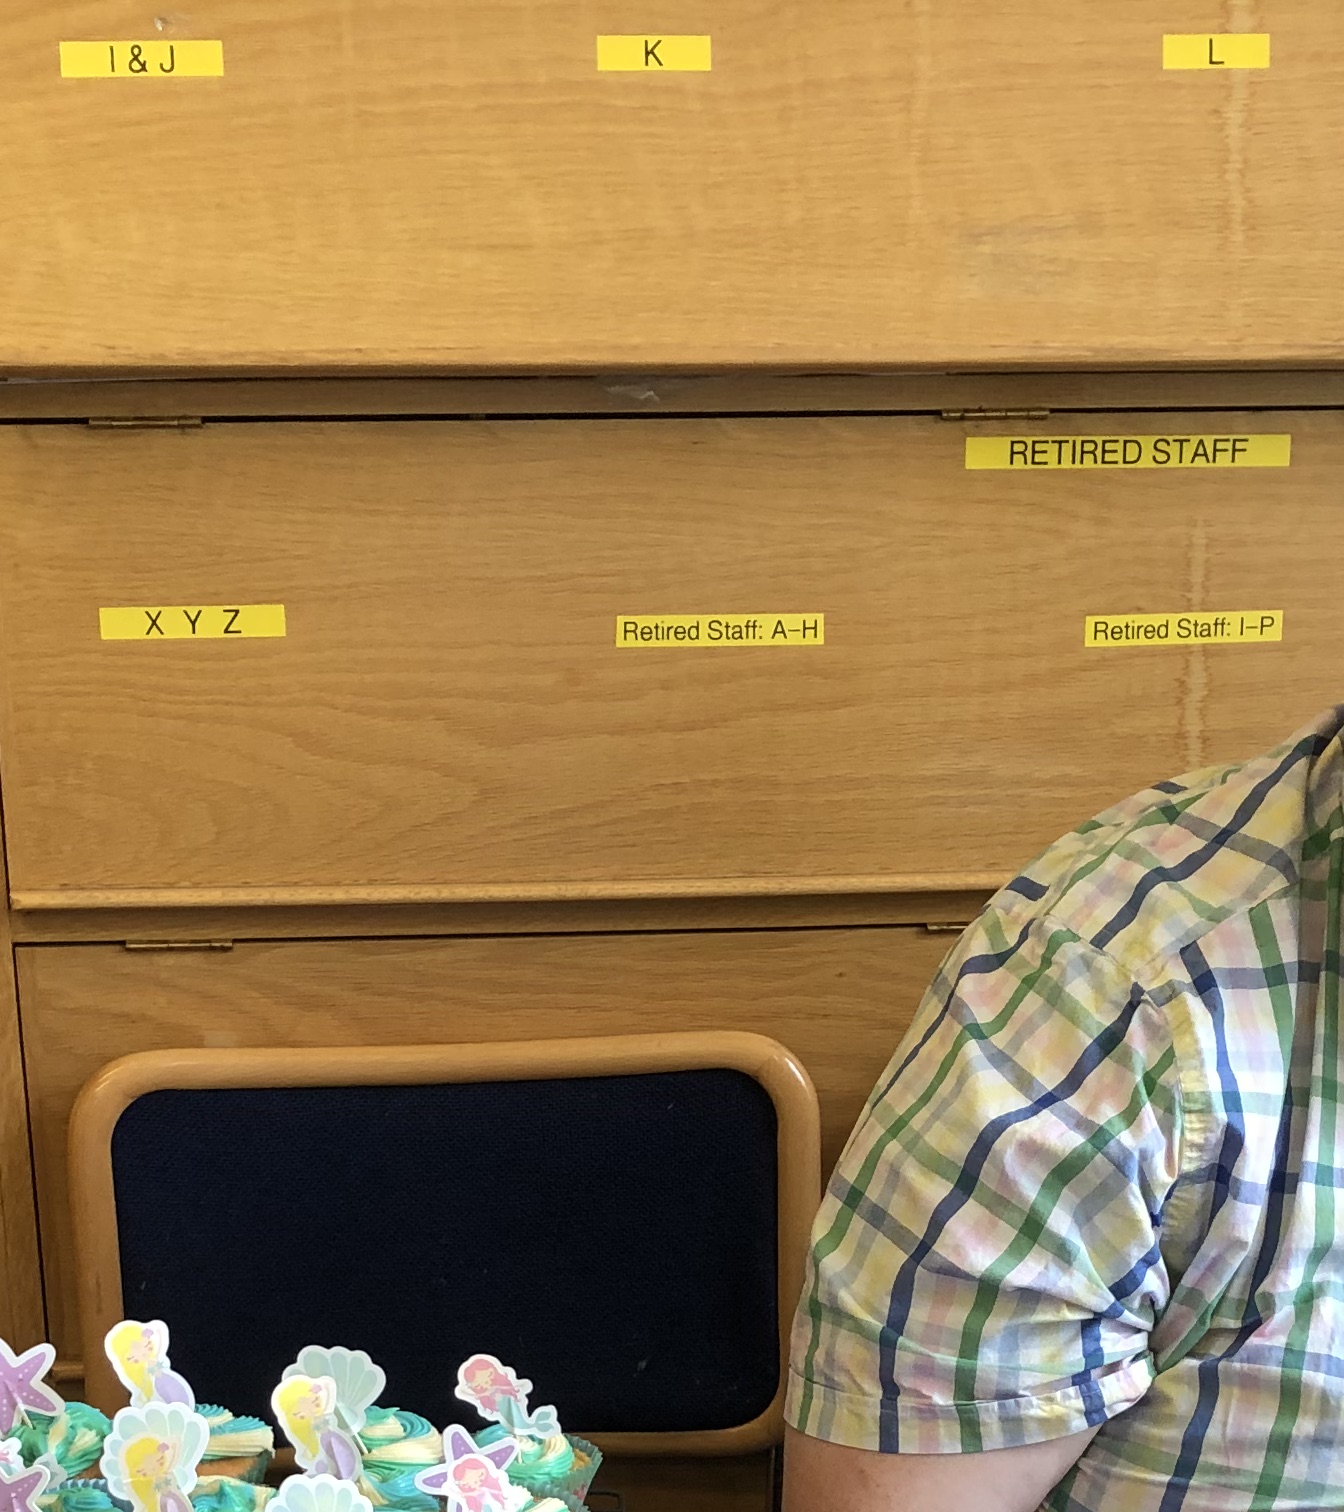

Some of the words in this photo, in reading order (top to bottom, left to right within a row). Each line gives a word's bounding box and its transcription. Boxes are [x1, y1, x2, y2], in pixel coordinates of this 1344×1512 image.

[129, 45, 148, 73] &
[160, 45, 175, 73] J
[644, 39, 664, 67] K
[1208, 38, 1225, 65] L
[1009, 438, 1143, 466] RETIRED
[1152, 436, 1249, 465] STAFF
[144, 610, 164, 636] X
[182, 609, 203, 635] Y
[222, 608, 242, 634] Z
[623, 620, 700, 642] Retired
[707, 619, 765, 641] Staff:
[1093, 618, 1169, 641] Retired
[1176, 617, 1234, 639] Staff:
